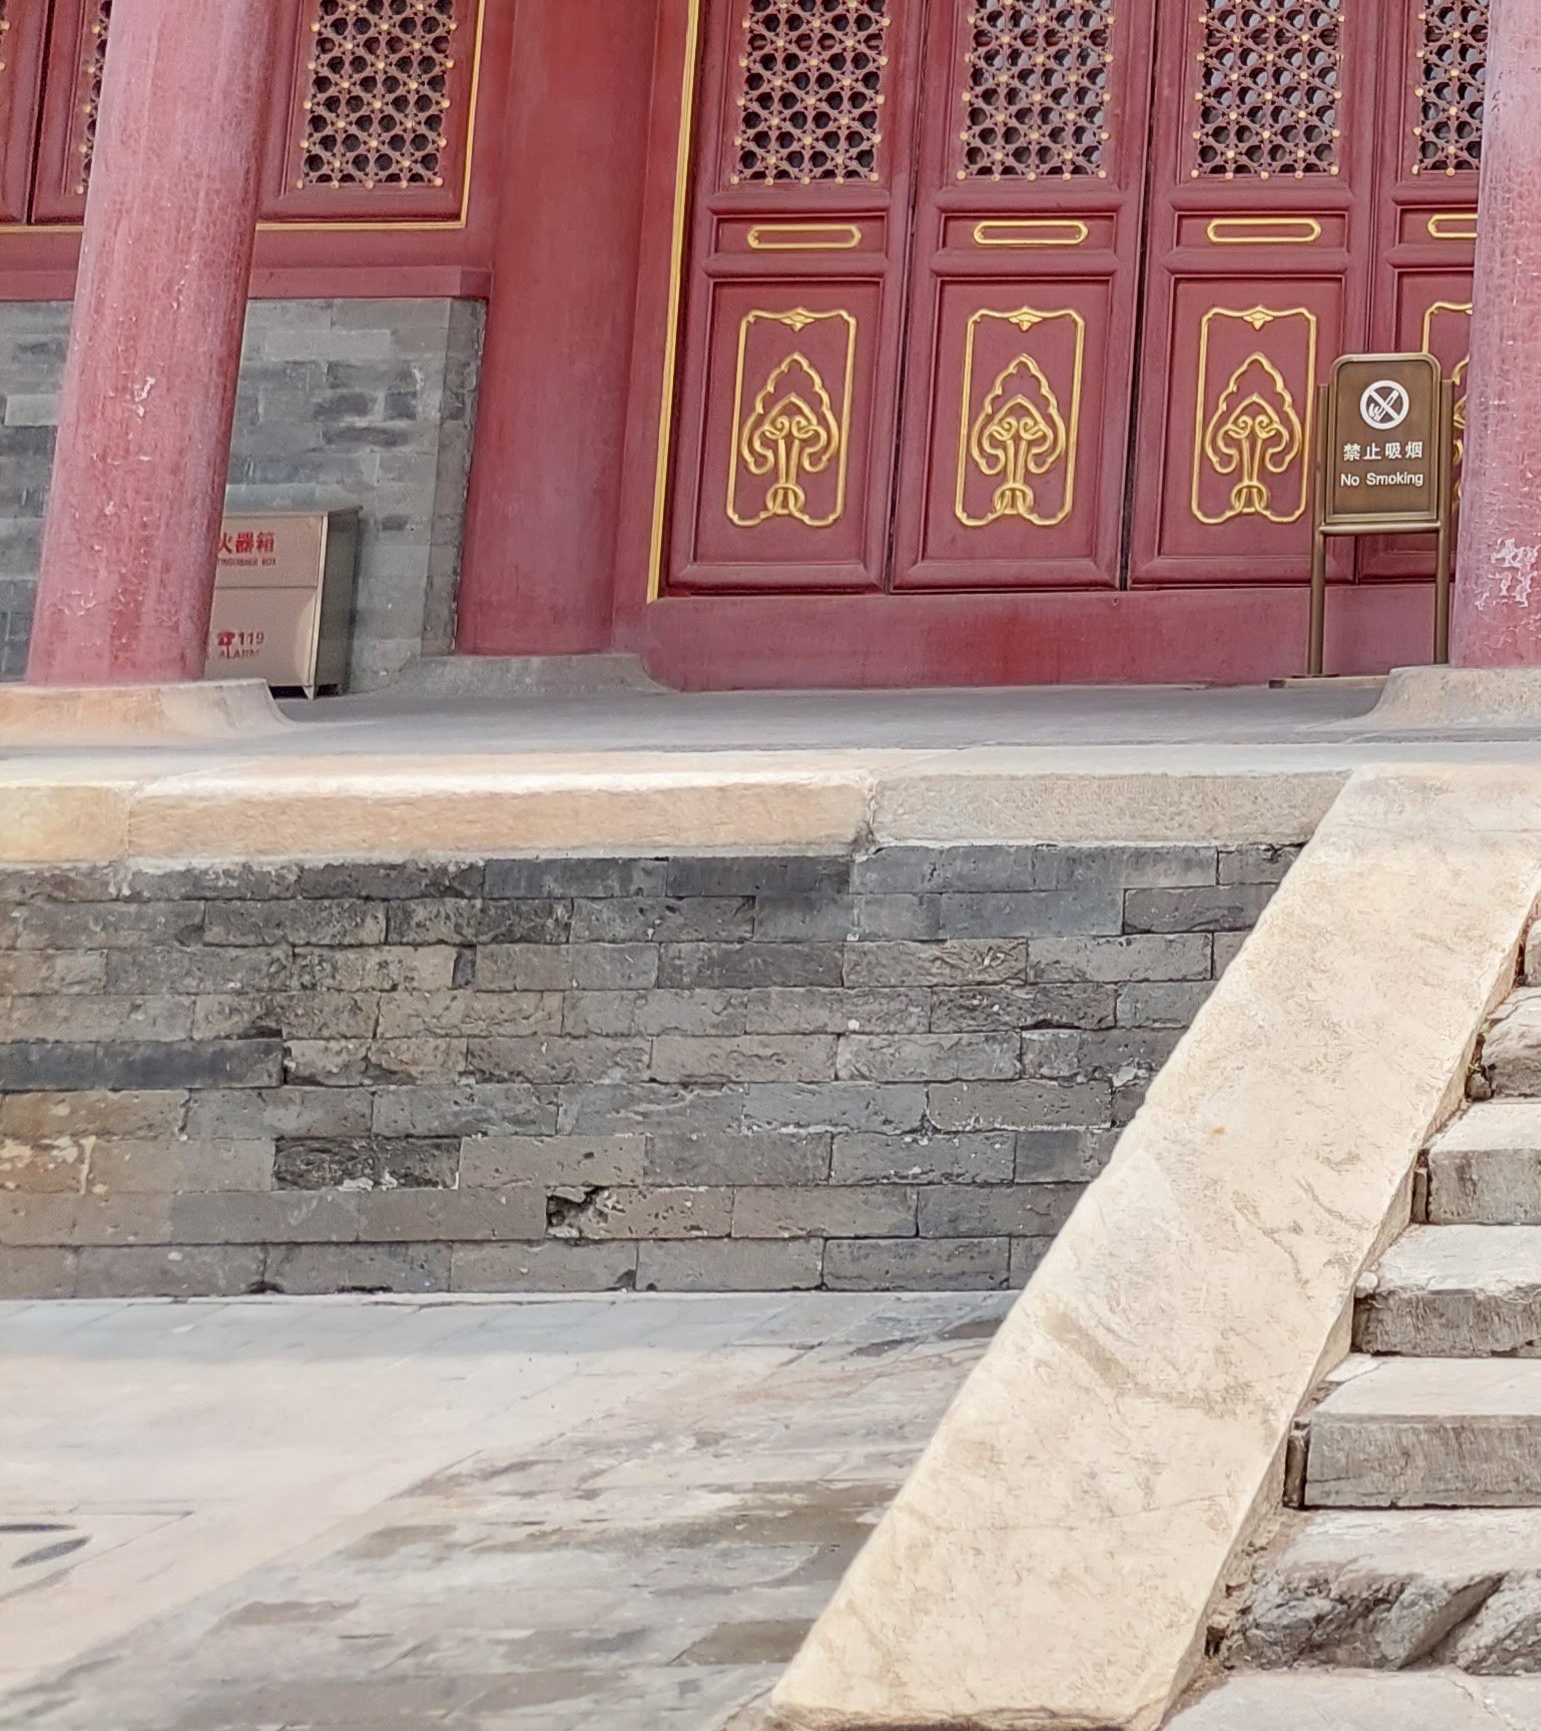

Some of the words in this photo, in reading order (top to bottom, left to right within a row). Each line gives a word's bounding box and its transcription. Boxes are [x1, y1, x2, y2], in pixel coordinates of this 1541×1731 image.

[1343, 441, 1424, 461] 禁止吸烟
[1340, 473, 1361, 487] No
[1366, 472, 1424, 487] Smoking
[238, 631, 265, 646] 119
